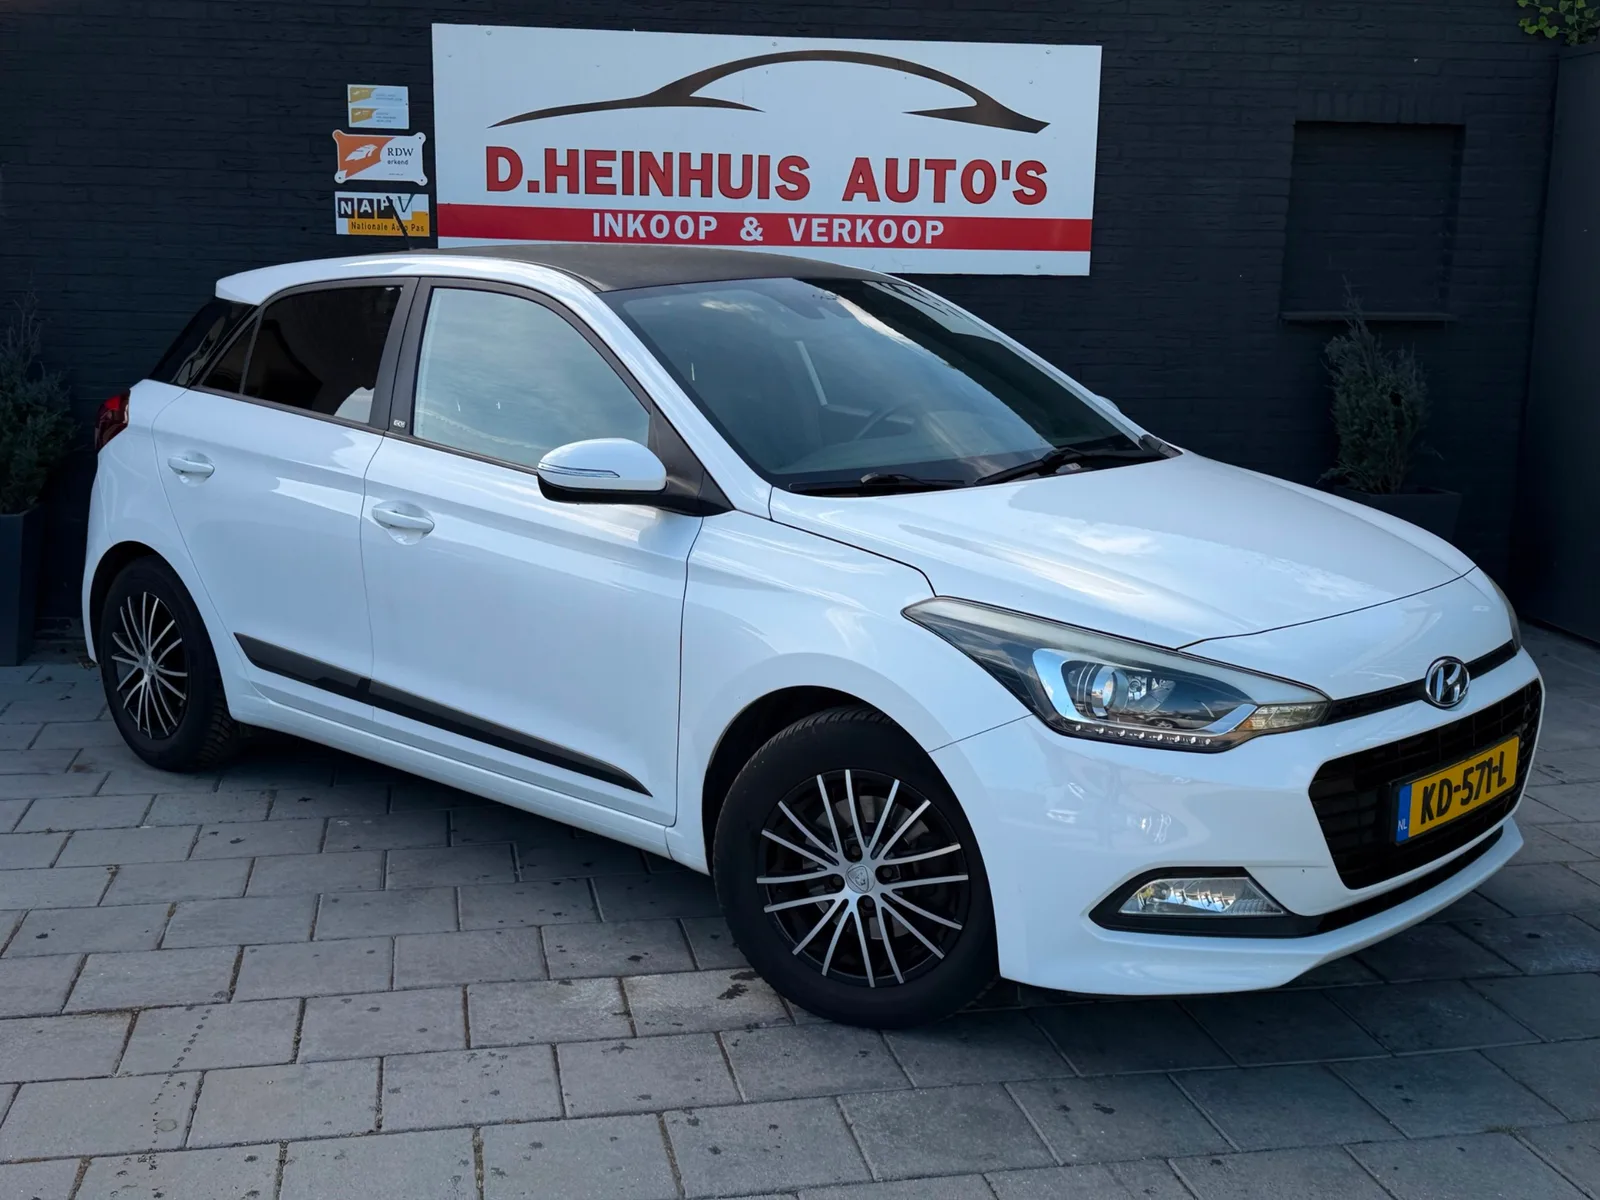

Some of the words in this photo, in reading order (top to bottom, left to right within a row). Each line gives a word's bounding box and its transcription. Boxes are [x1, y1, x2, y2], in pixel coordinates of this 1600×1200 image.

[387, 147, 414, 157] RDW
[485, 146, 811, 202] D.HEINHUIS
[842, 157, 1049, 206] AUTO'S
[351, 221, 388, 231] Nationale
[391, 223, 408, 232] Auo
[411, 224, 424, 232] Pas
[592, 211, 718, 242] INKOOP
[740, 216, 764, 243] &
[788, 217, 945, 246] VERKOOP
[1420, 751, 1507, 825] KD-571-L
[1397, 818, 1408, 831] NL
